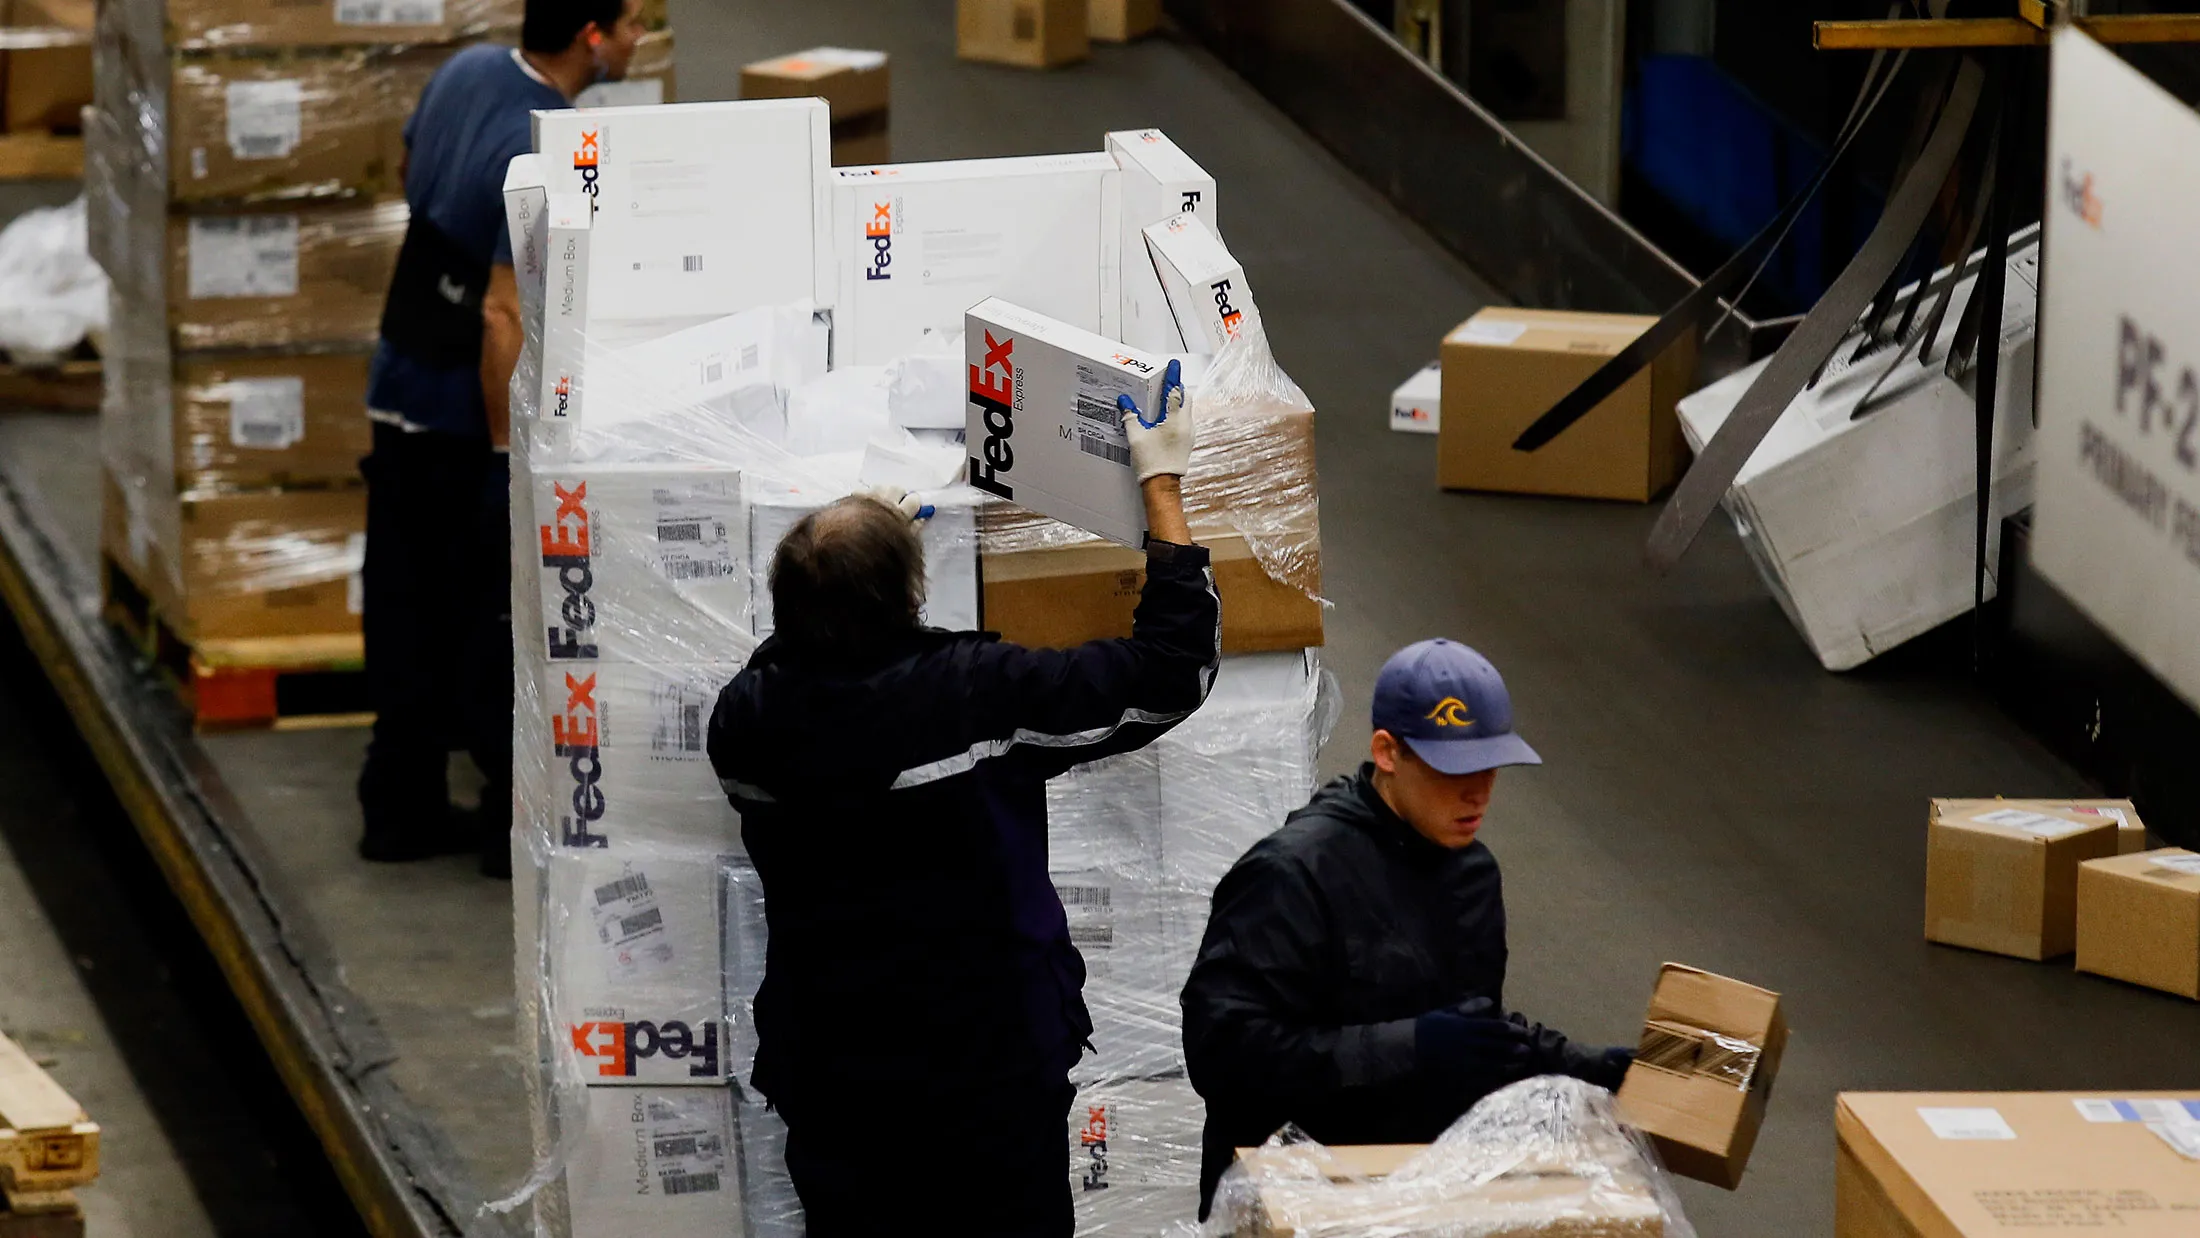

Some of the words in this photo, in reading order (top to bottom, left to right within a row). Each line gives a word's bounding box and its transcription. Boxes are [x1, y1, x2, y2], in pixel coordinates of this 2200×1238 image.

[574, 130, 600, 212] edEx
[564, 237, 576, 260] Box
[866, 202, 891, 281] FedEx
[561, 264, 575, 317] Medium
[554, 376, 570, 417] FedEx
[969, 327, 1014, 501] FedEx
[1013, 367, 1025, 412] Express
[1059, 424, 1073, 441] M
[591, 509, 602, 557] Express
[541, 480, 598, 658] FedEx
[600, 700, 611, 748] Express
[552, 671, 609, 848] FedEx
[583, 1007, 625, 1020] Express
[571, 1020, 719, 1077] FedEx
[631, 1092, 645, 1124] Box
[634, 1128, 650, 1196] Medium
